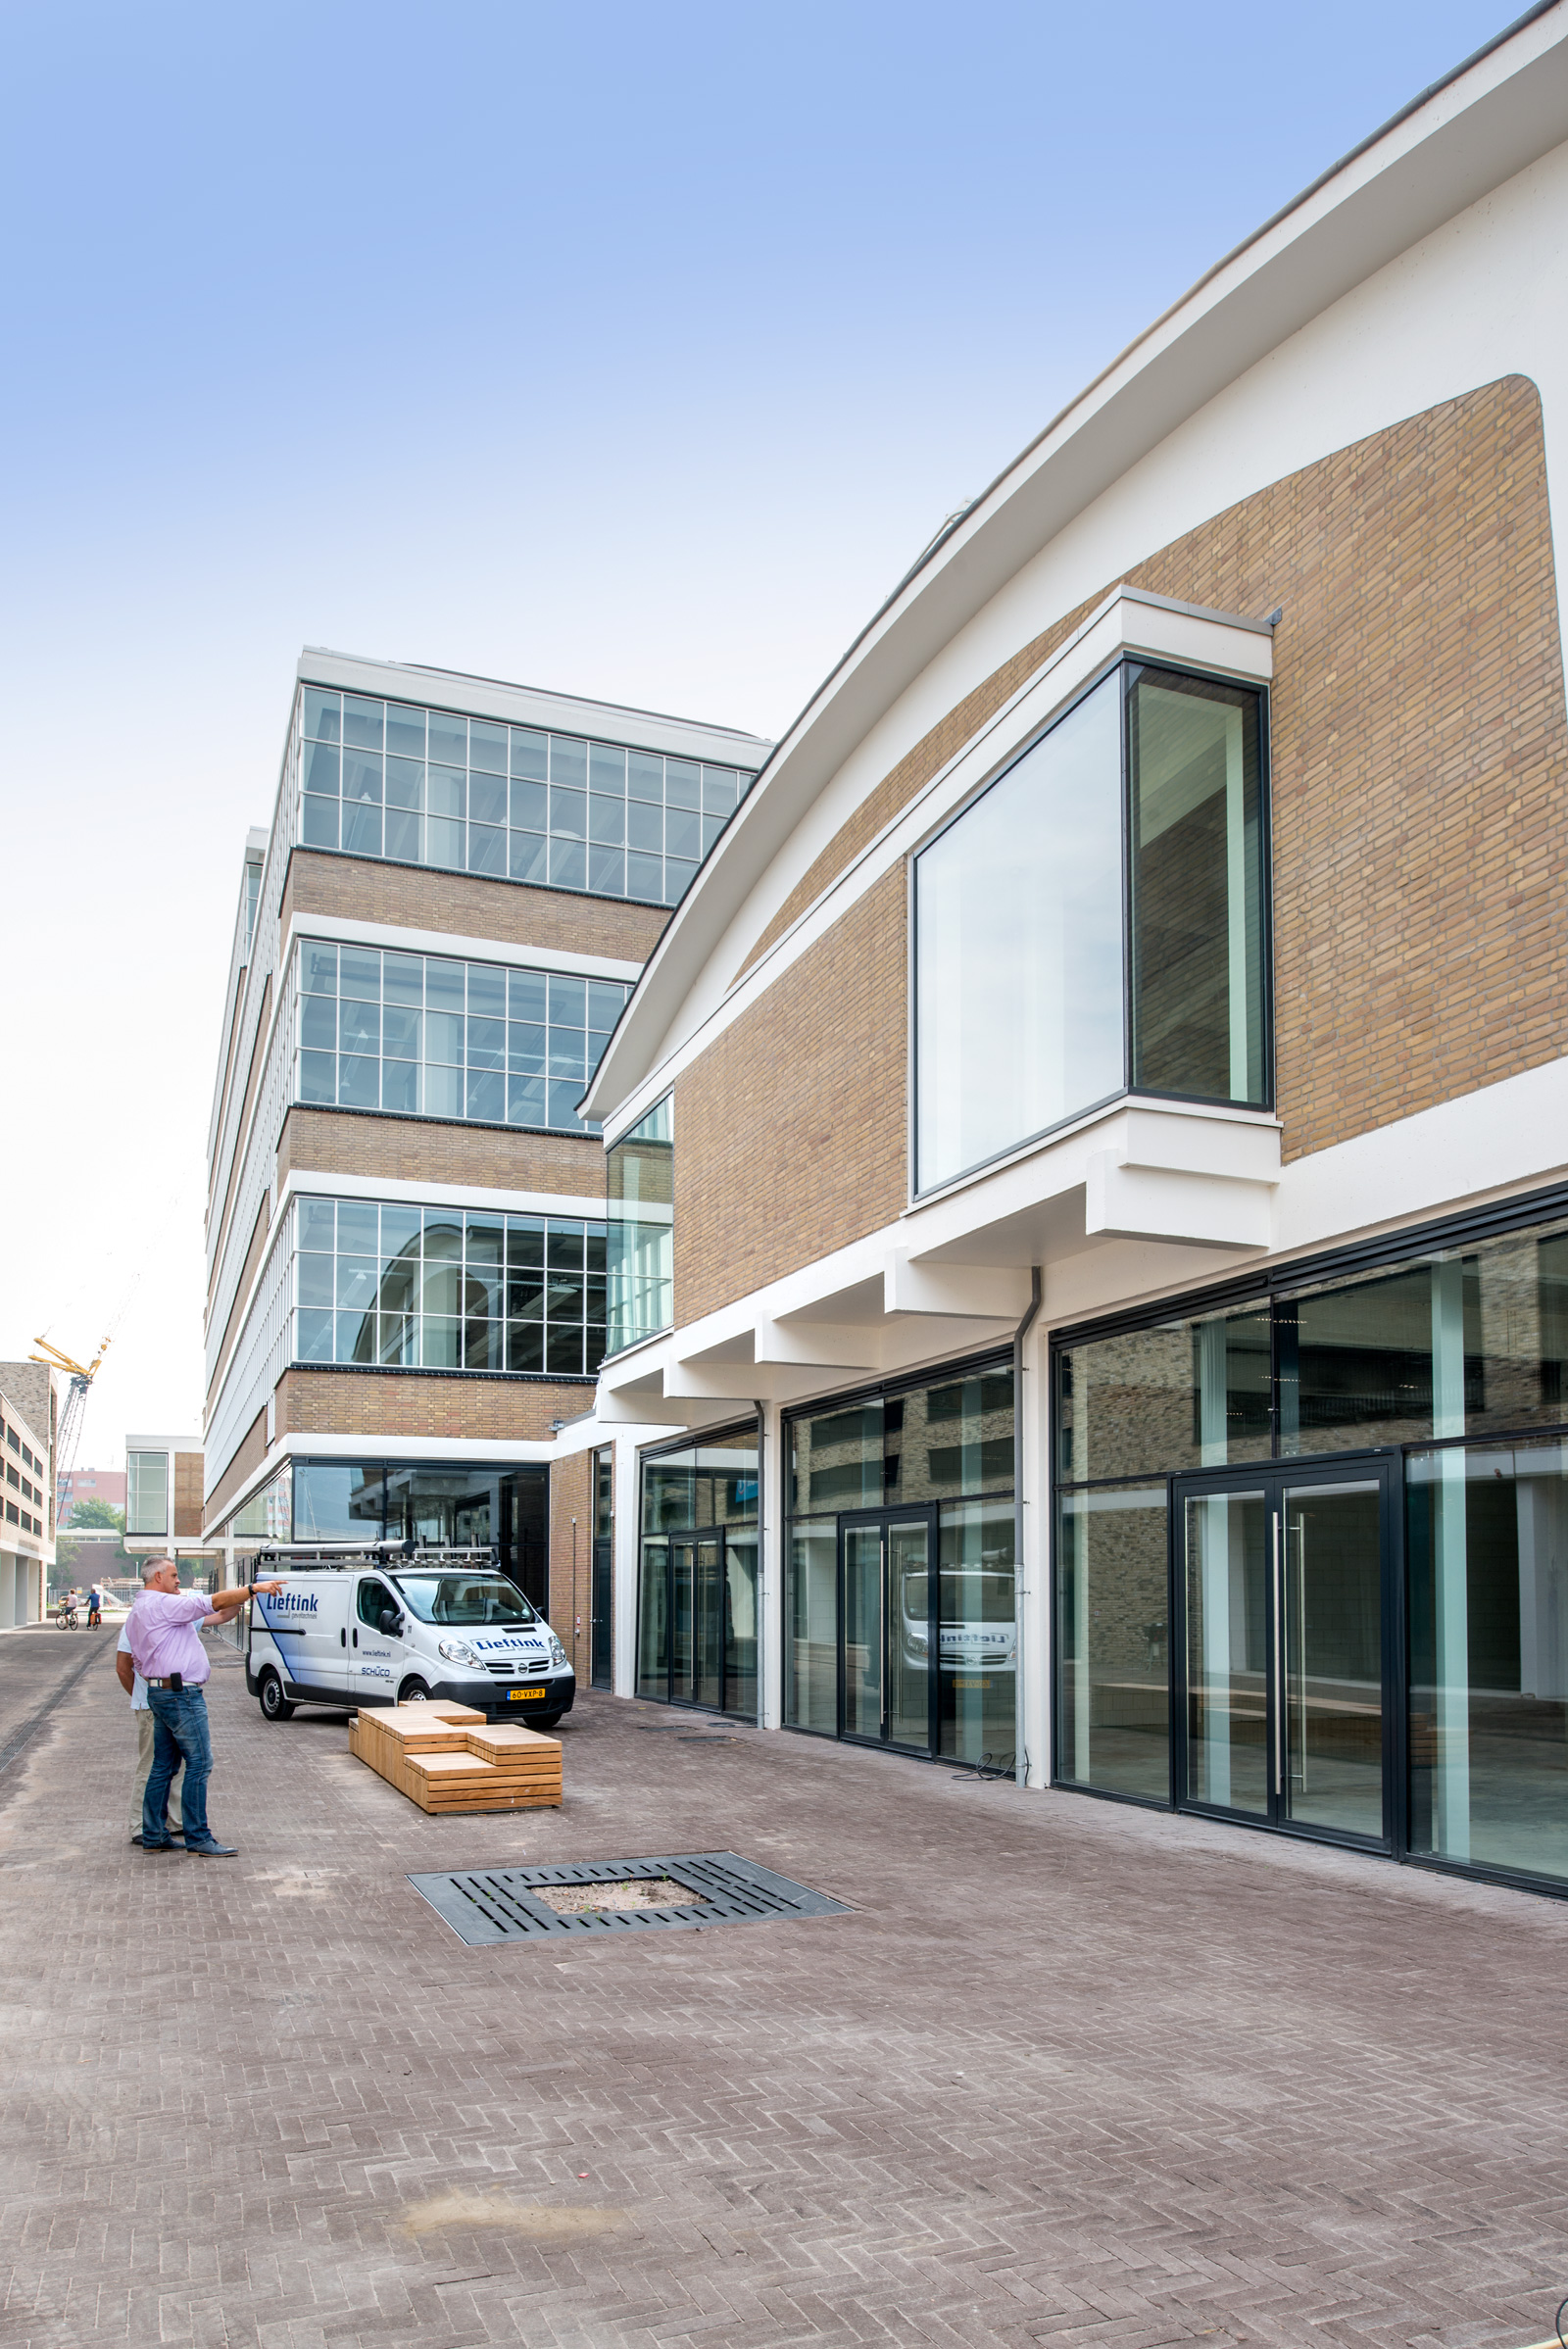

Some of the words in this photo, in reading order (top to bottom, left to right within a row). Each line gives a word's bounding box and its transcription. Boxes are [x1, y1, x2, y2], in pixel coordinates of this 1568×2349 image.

[267, 1592, 318, 1612] Lieftink
[476, 1639, 545, 1650] Lieftink
[512, 1689, 543, 1699] 60-VXP-8
